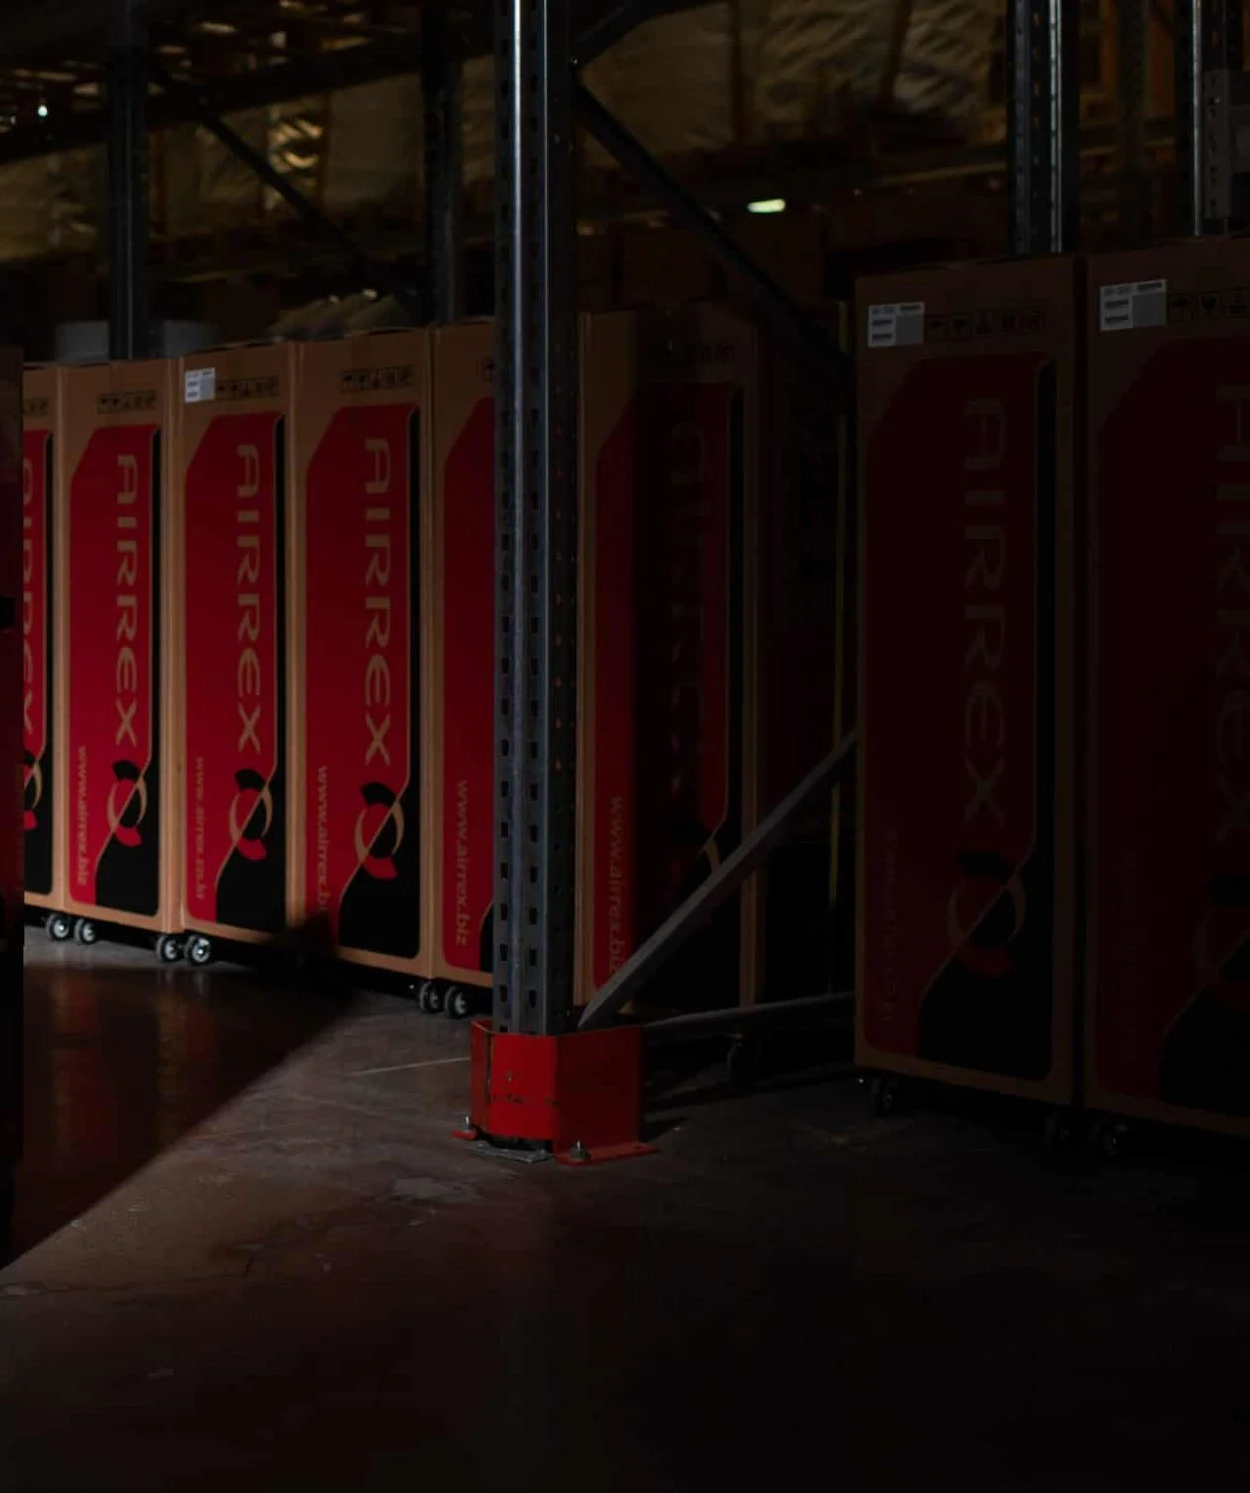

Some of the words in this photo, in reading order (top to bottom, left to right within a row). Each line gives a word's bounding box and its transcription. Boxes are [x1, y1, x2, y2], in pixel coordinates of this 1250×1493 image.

[116, 453, 138, 747] AIRREX
[237, 444, 261, 755] AIRREX
[364, 436, 391, 767] AIRREX
[963, 397, 1006, 828] AIRREX
[76, 745, 90, 886] www.airrex.biz
[456, 779, 470, 947] www.airrex.biz
